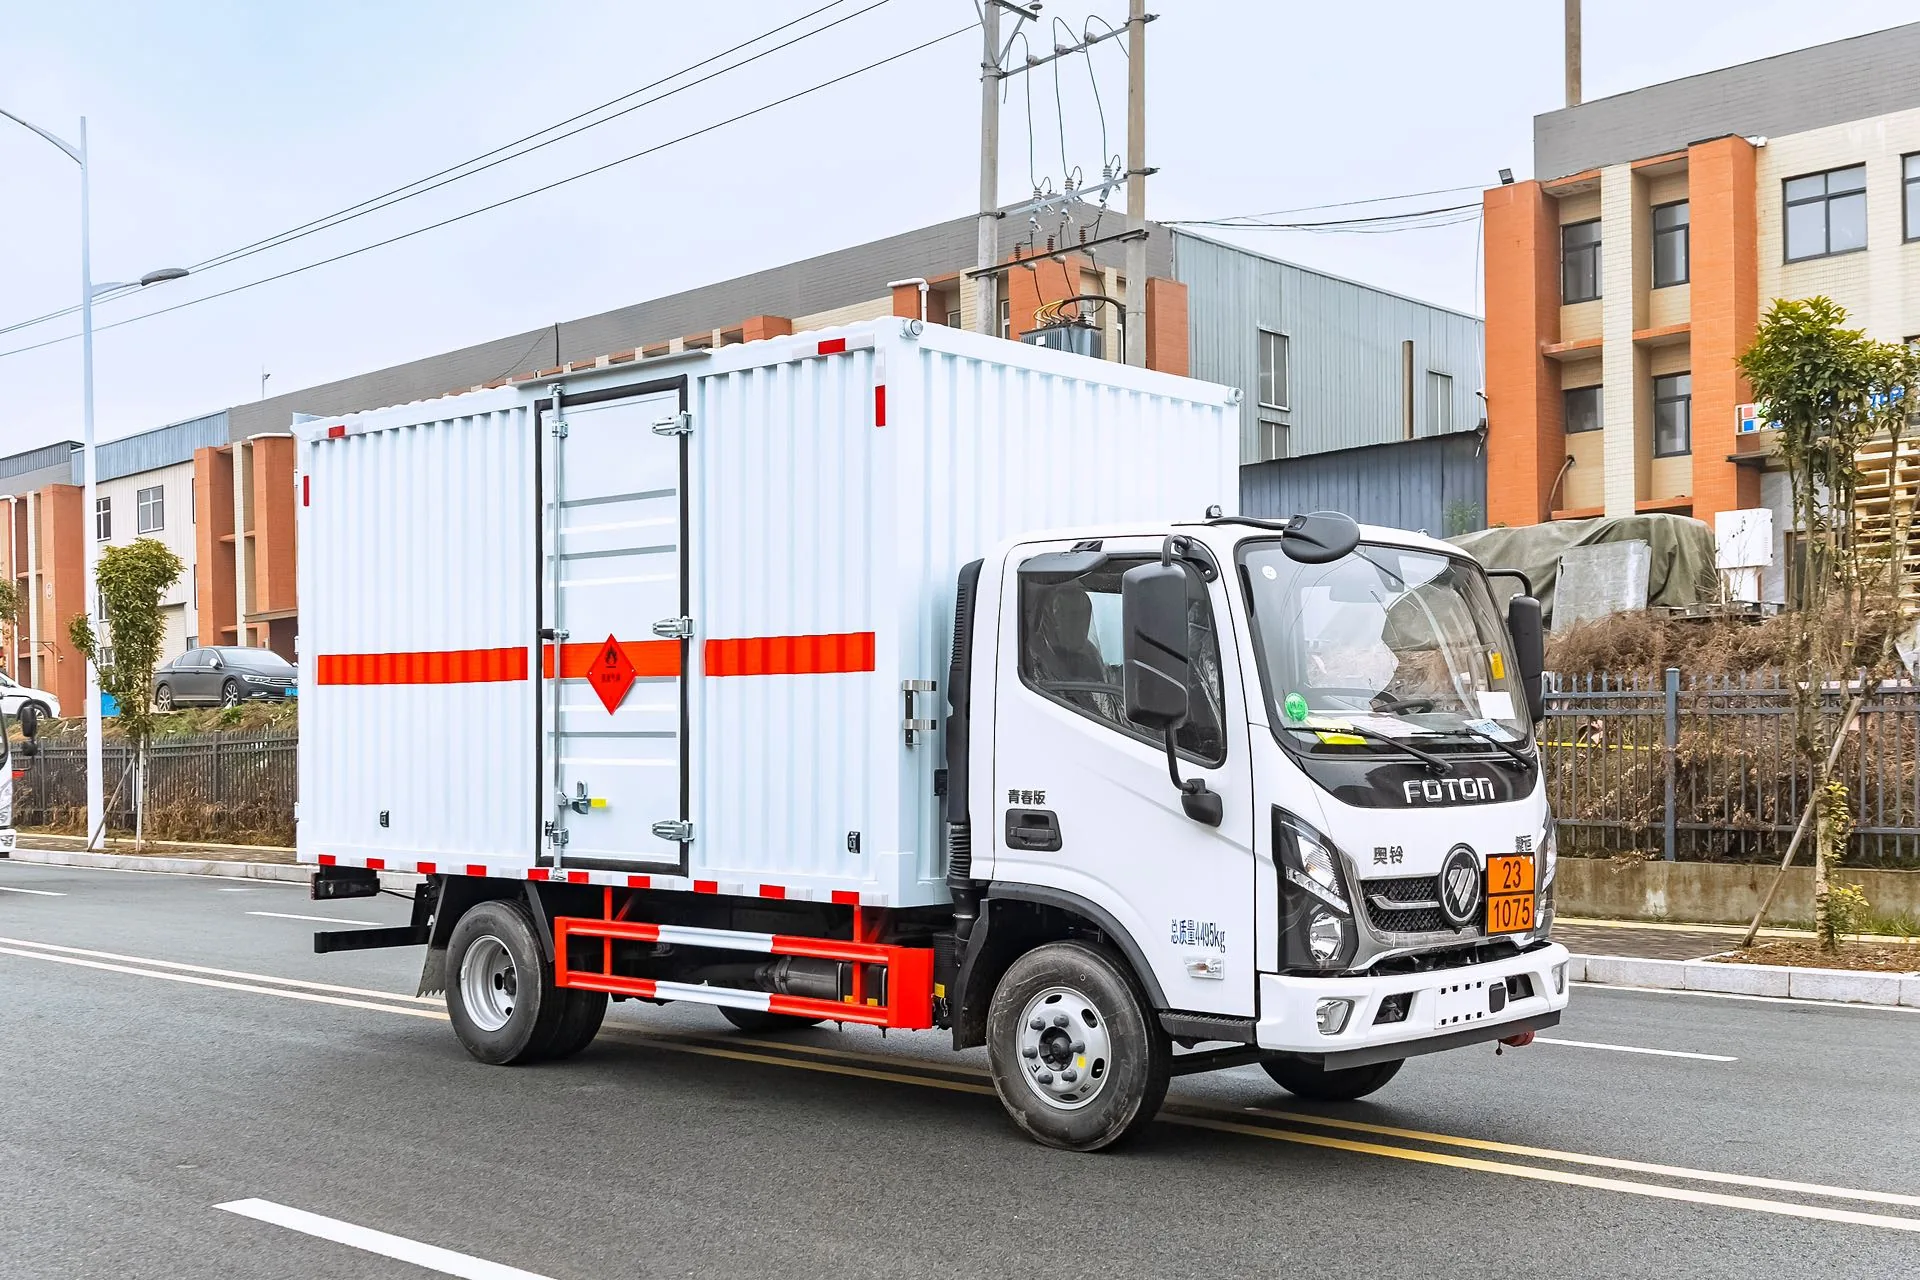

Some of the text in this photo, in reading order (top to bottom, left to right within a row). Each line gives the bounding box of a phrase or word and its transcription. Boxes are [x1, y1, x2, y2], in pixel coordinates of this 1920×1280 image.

[1008, 789, 1046, 806] 青春版
[1403, 777, 1496, 804] FOTON
[1373, 845, 1404, 866] 奥铃
[1503, 860, 1522, 889] 23
[1493, 898, 1531, 928] 1075
[1171, 919, 1225, 953] 总质量4495kg
